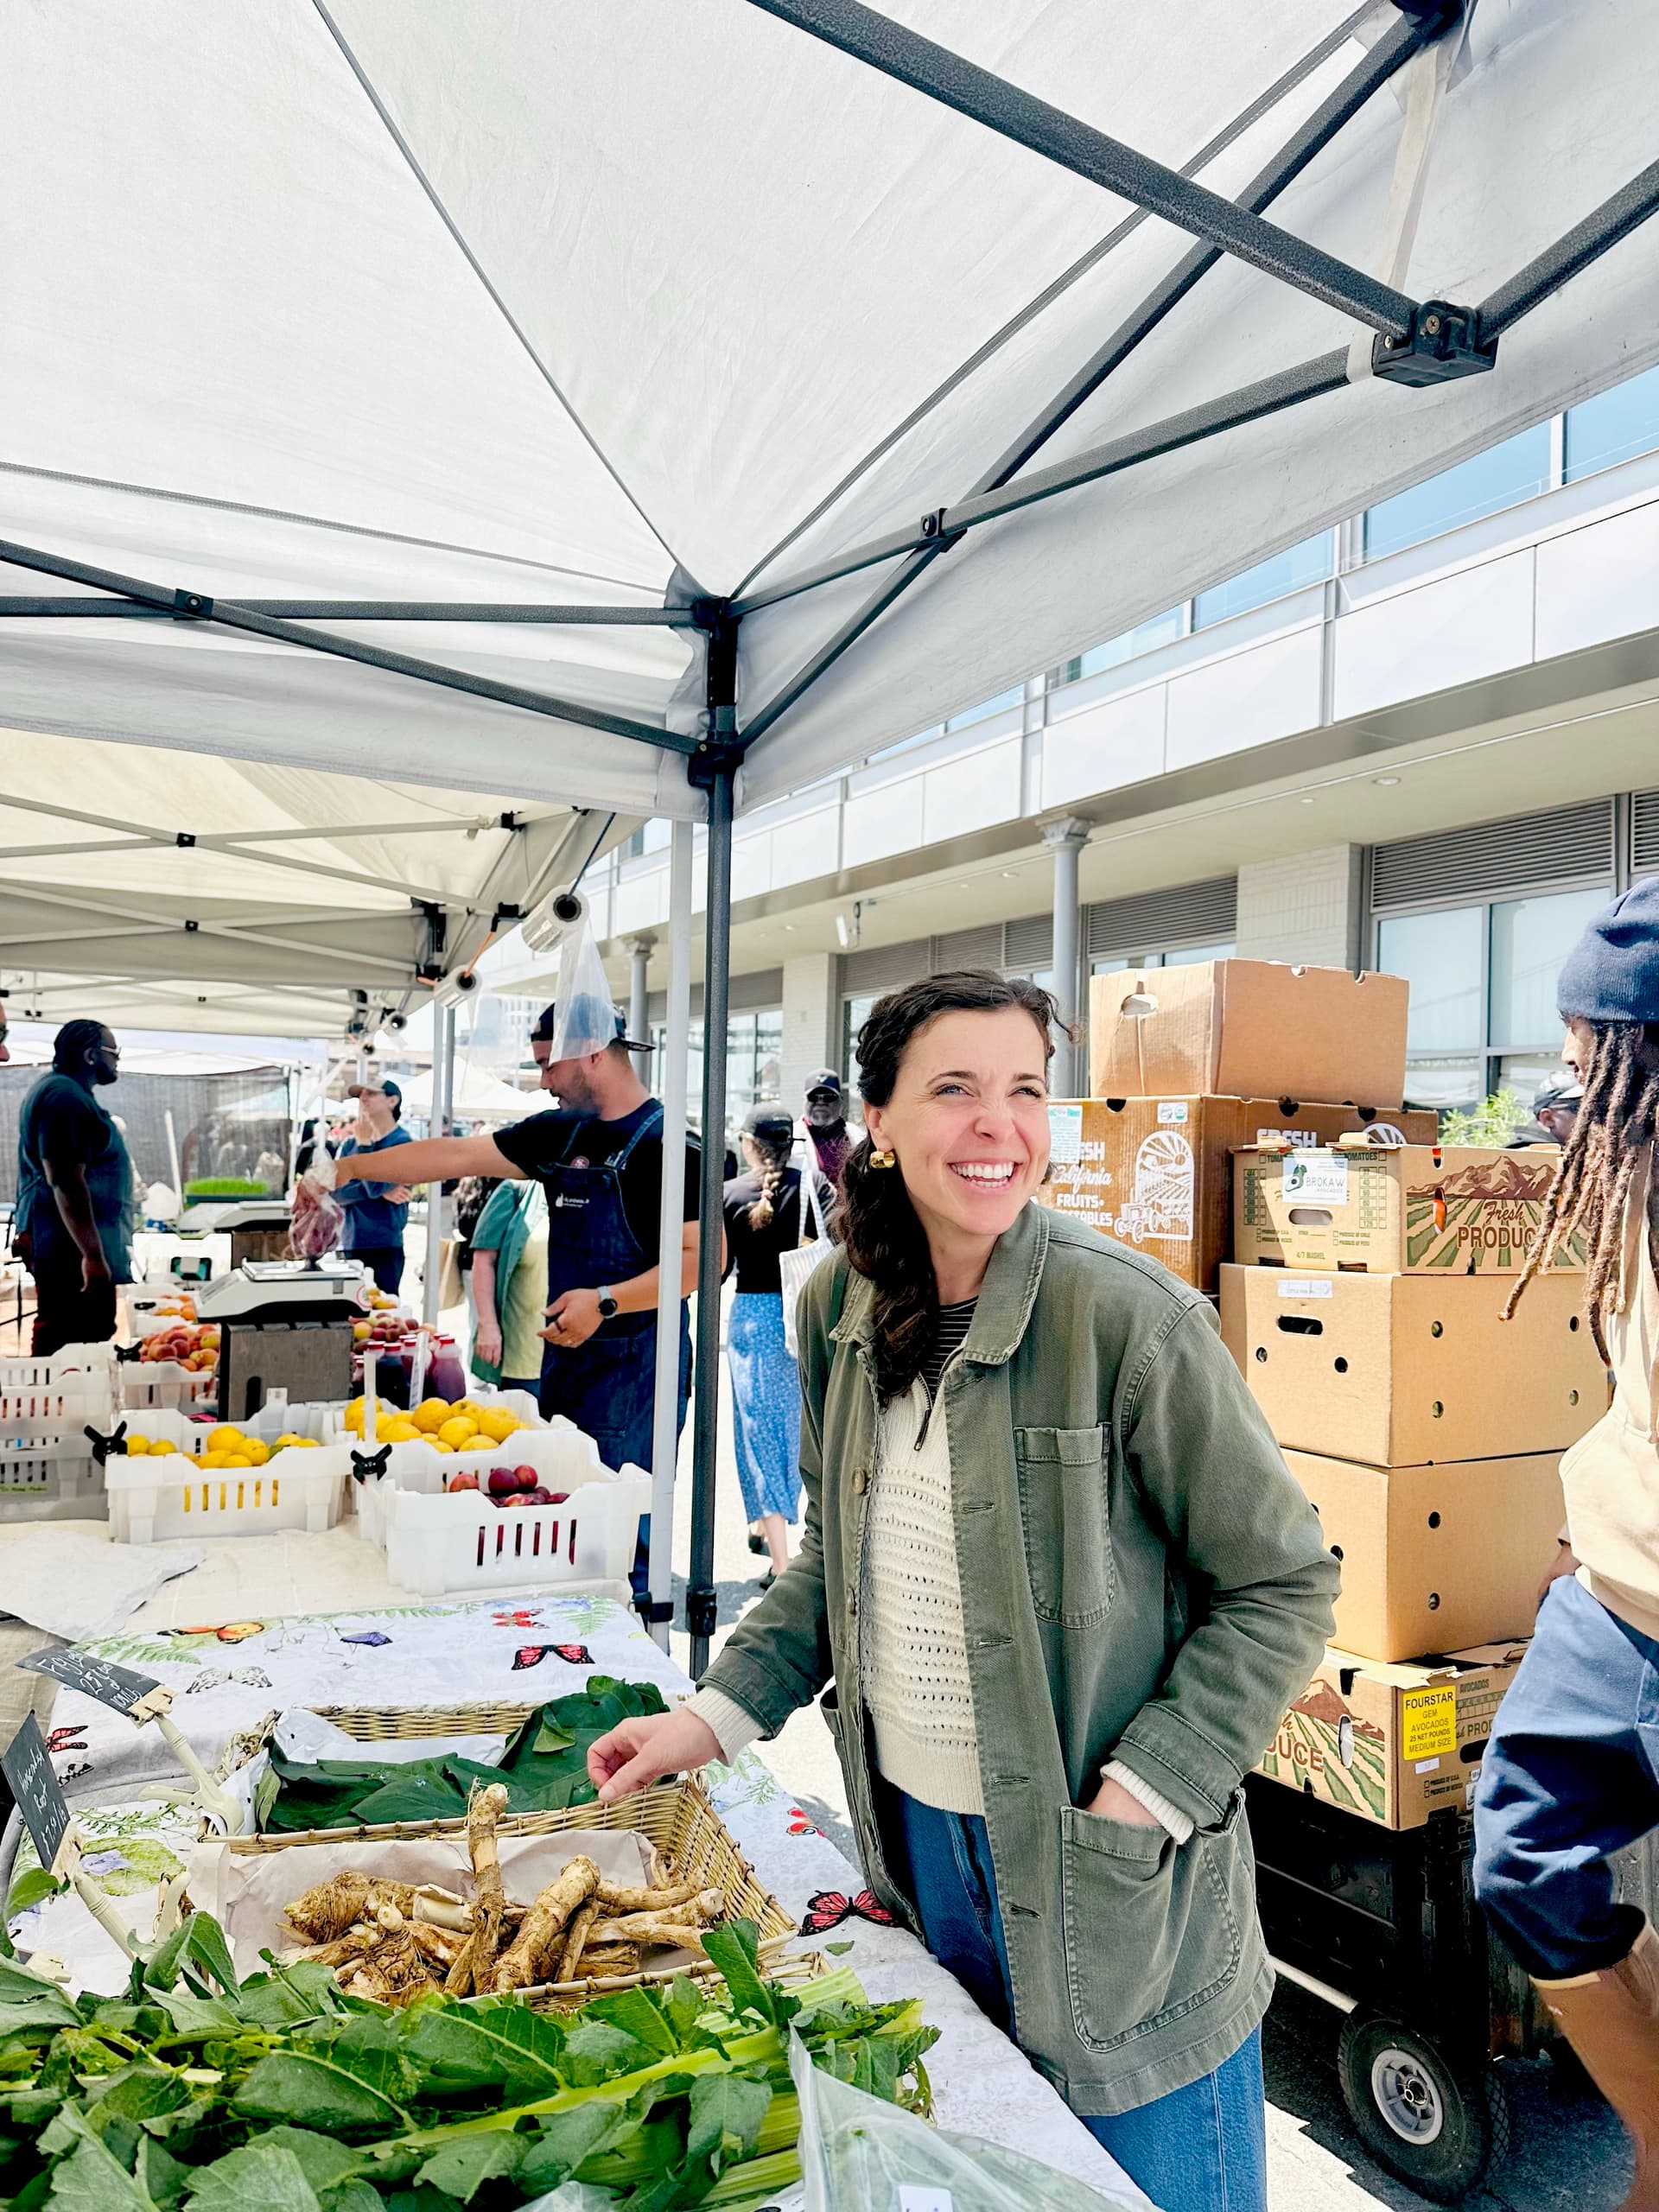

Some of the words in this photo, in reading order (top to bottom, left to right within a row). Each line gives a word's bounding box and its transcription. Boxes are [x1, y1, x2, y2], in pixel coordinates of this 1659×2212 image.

[1080, 1141, 1105, 1161] ESH
[1052, 1165, 1112, 1193] California
[1306, 1176, 1345, 1187] BROKAW
[1484, 1201, 1524, 1224] Fresh
[1458, 1227, 1535, 1249] PRODUC
[1405, 1691, 1453, 1710] FOURSTAR
[1422, 1709, 1438, 1719] GEM
[1411, 1718, 1449, 1732] AVOCADOS
[1417, 1732, 1427, 1741] NET
[1428, 1728, 1451, 1738] POUNDS
[1409, 1741, 1435, 1753] MEDIUM
[1437, 1737, 1452, 1748] SIZE
